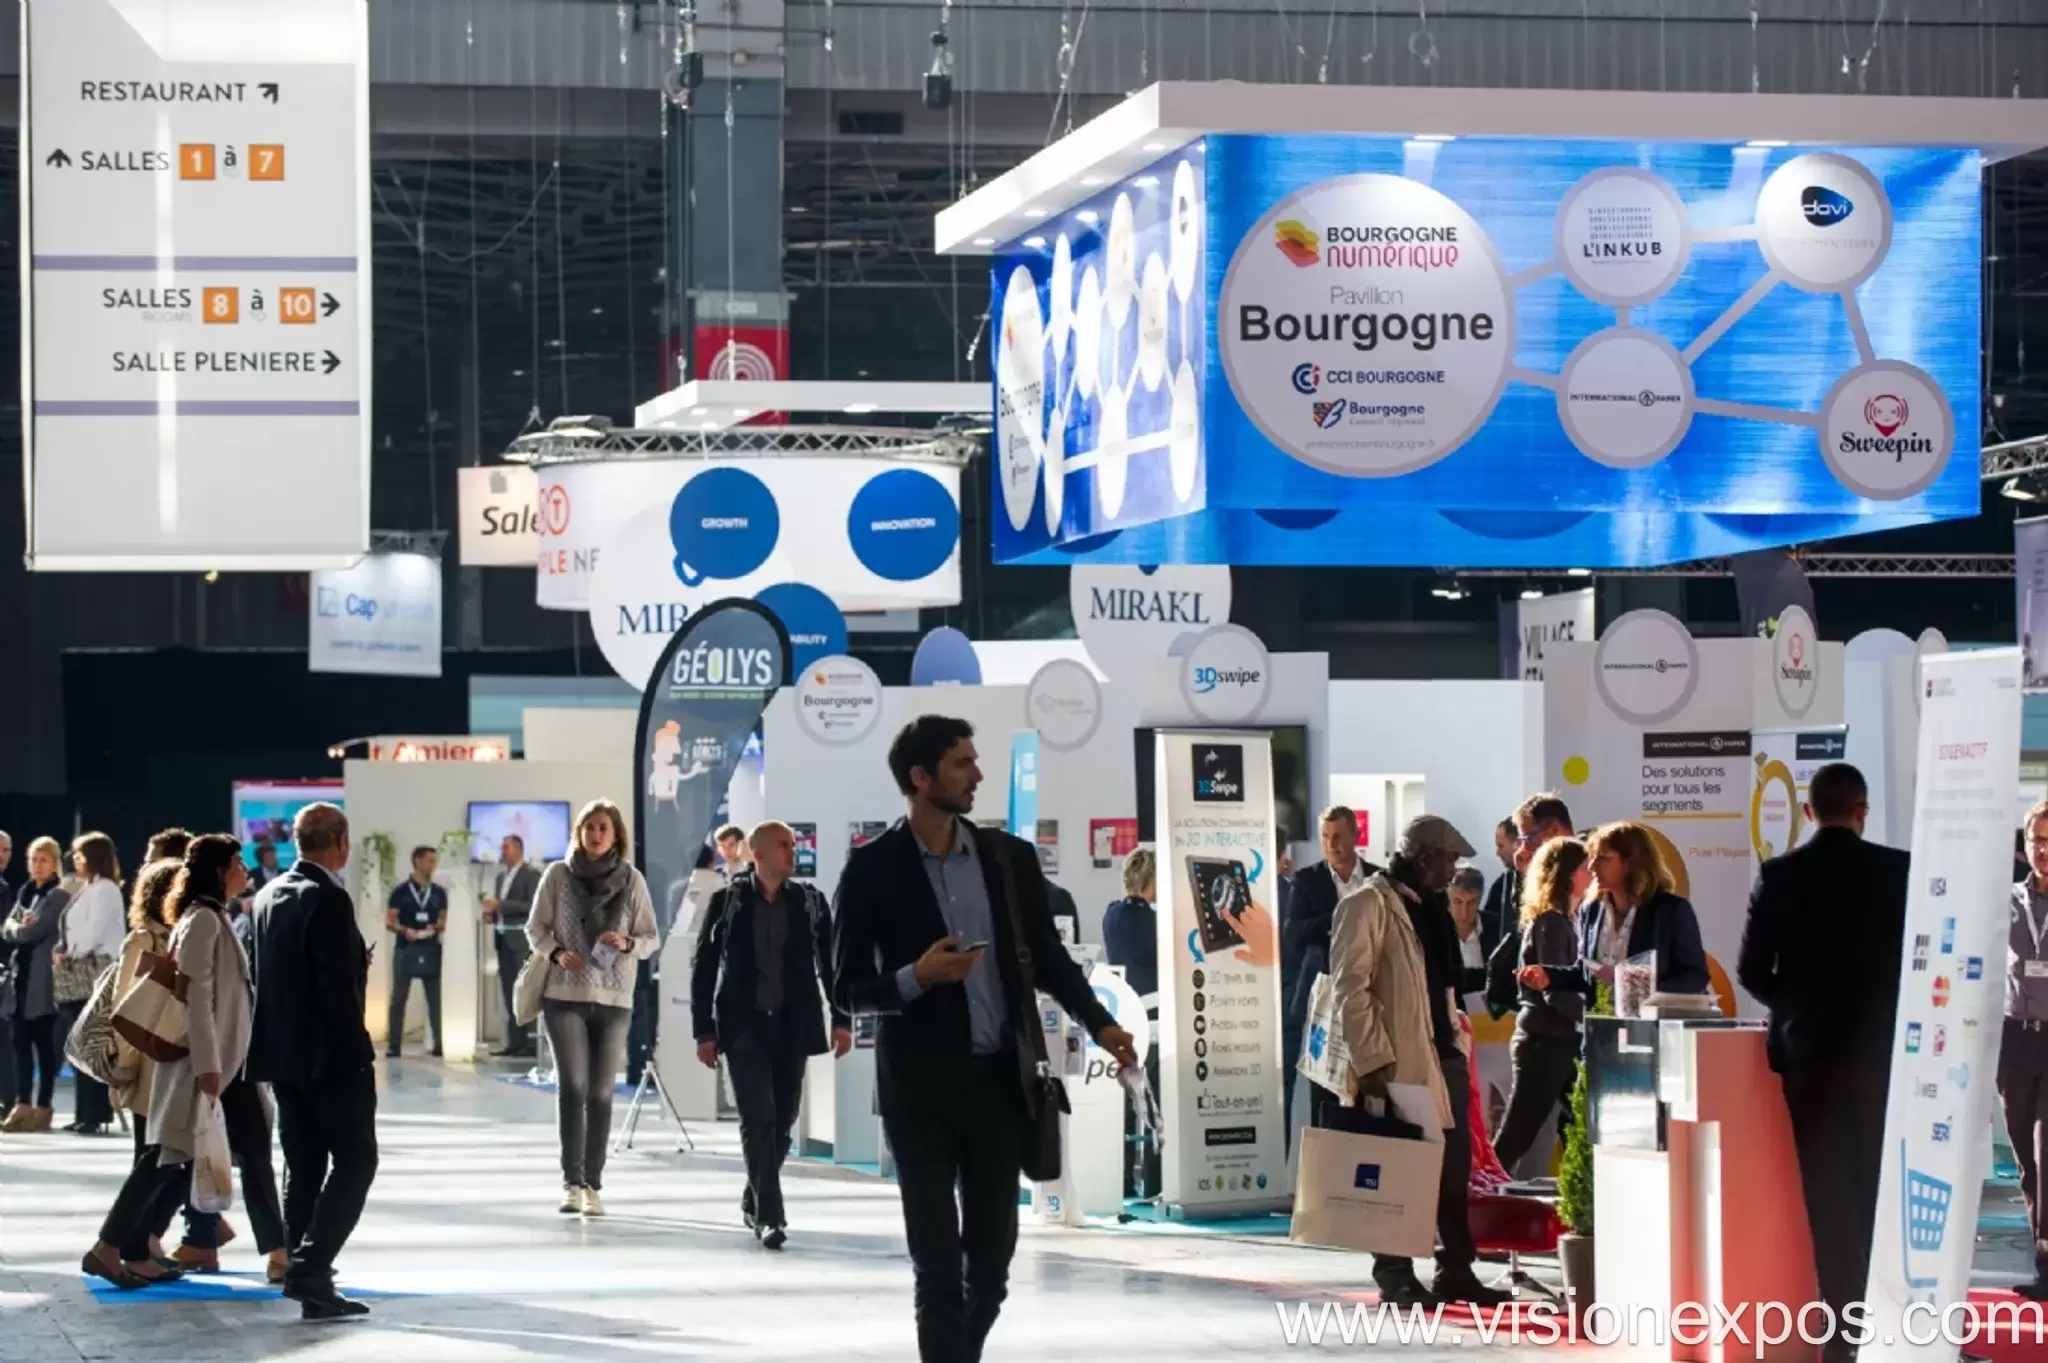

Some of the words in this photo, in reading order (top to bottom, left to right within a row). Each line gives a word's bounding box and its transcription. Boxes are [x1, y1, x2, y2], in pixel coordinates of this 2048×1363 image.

[81, 81, 247, 102] RESTAURANT
[81, 150, 170, 171] SALLES
[192, 151, 202, 173] 1
[223, 145, 237, 167] à
[259, 151, 275, 174] 7
[1326, 226, 1459, 242] BOURGOGNE
[1326, 242, 1460, 271] numérique
[1583, 242, 1662, 258] L'INKUB
[102, 288, 192, 309] SALLES
[211, 293, 230, 317] 8
[250, 288, 264, 311] à
[282, 293, 313, 317] 10
[1329, 285, 1404, 305] Pavillon
[1239, 304, 1495, 351] Bourgogne
[112, 351, 187, 372] SALLE
[195, 351, 317, 372] PLENIERE
[1326, 370, 1353, 384] CCI
[1355, 370, 1446, 384] BOURGOGNE
[1349, 402, 1426, 417] Bourgogne
[1839, 430, 1933, 462] Sweepin
[701, 518, 749, 529] GROWTH
[871, 518, 936, 532] INNOVATION
[1088, 586, 1210, 624] MIRAKL
[672, 640, 773, 685] GÉOLYS
[804, 694, 874, 709] Bourgogne
[1642, 765, 1668, 779] Des
[1670, 765, 1726, 778] solutions
[1642, 784, 1671, 796] pour
[1673, 782, 1702, 795] tous
[1703, 781, 1722, 794] les
[1642, 799, 1704, 815] segments
